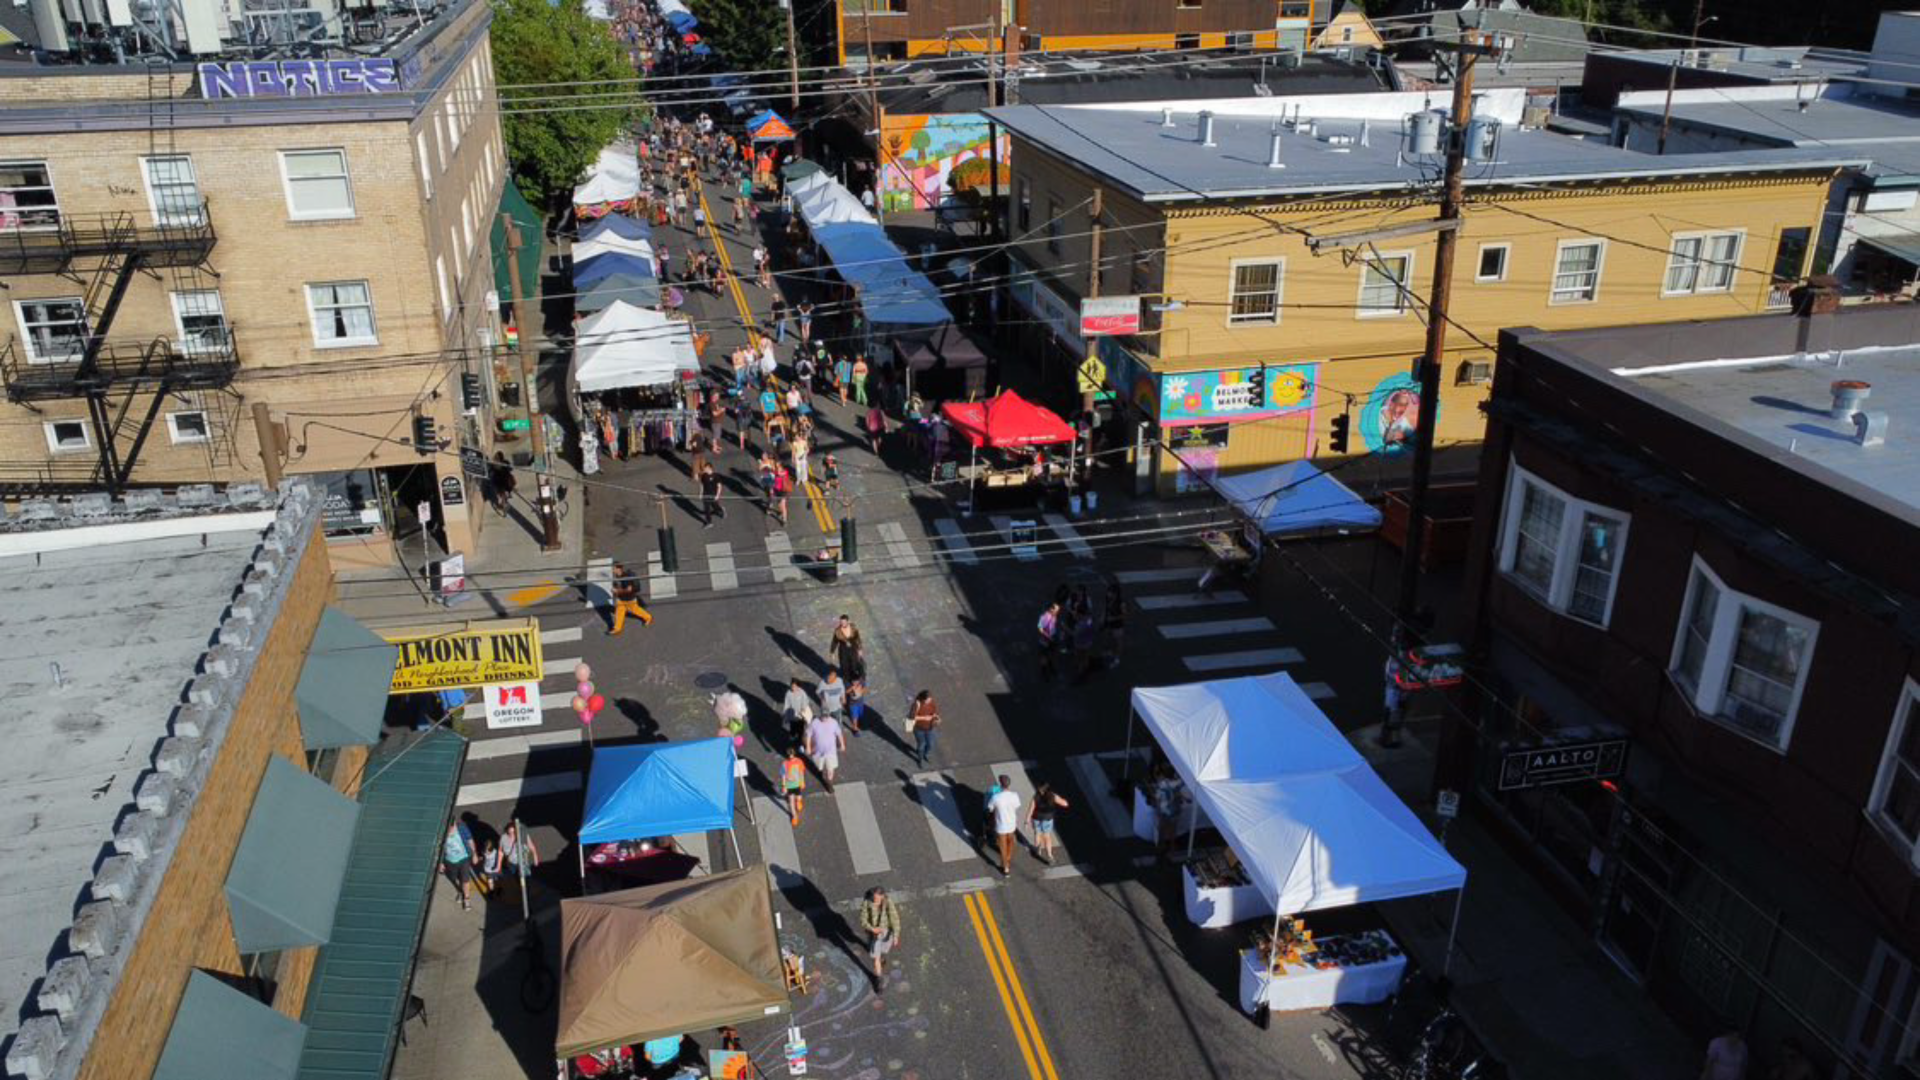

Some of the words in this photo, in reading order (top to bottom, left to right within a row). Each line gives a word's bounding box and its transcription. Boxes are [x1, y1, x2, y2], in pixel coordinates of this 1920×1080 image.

[198, 58, 401, 99] NOTICE
[1217, 387, 1248, 396] BELMO
[1218, 396, 1250, 405] MARKE
[490, 633, 532, 666] INN
[409, 663, 479, 680] Neighborhood
[426, 676, 471, 686] GAMES
[484, 671, 534, 681] DRINKS
[493, 707, 534, 718] OREGON
[499, 715, 530, 724] LOTTERY
[1533, 750, 1595, 767] AALTO
